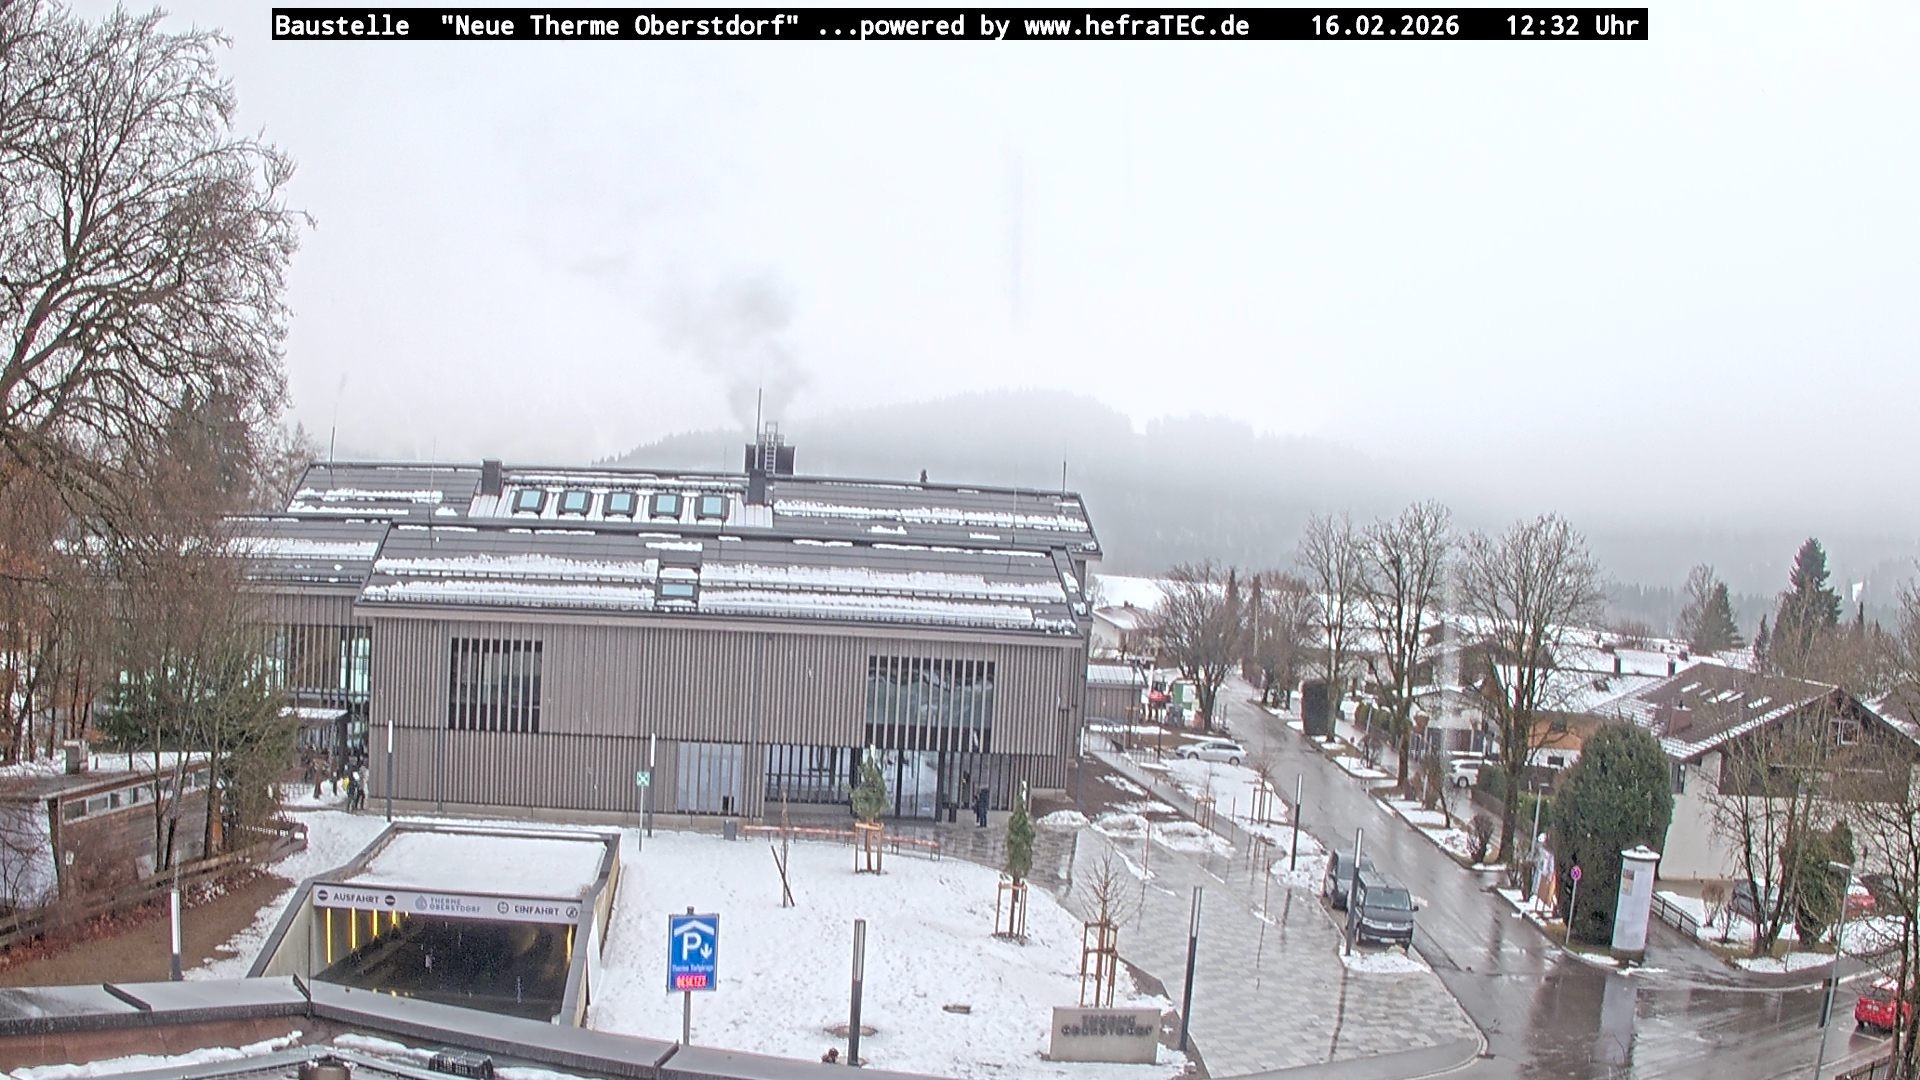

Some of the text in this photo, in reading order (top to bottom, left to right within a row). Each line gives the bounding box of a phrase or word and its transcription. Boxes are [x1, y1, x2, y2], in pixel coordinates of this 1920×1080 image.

[333, 892, 380, 904] AUSFAHRT
[514, 904, 560, 917] EINFAHRT
[683, 932, 702, 960] P
